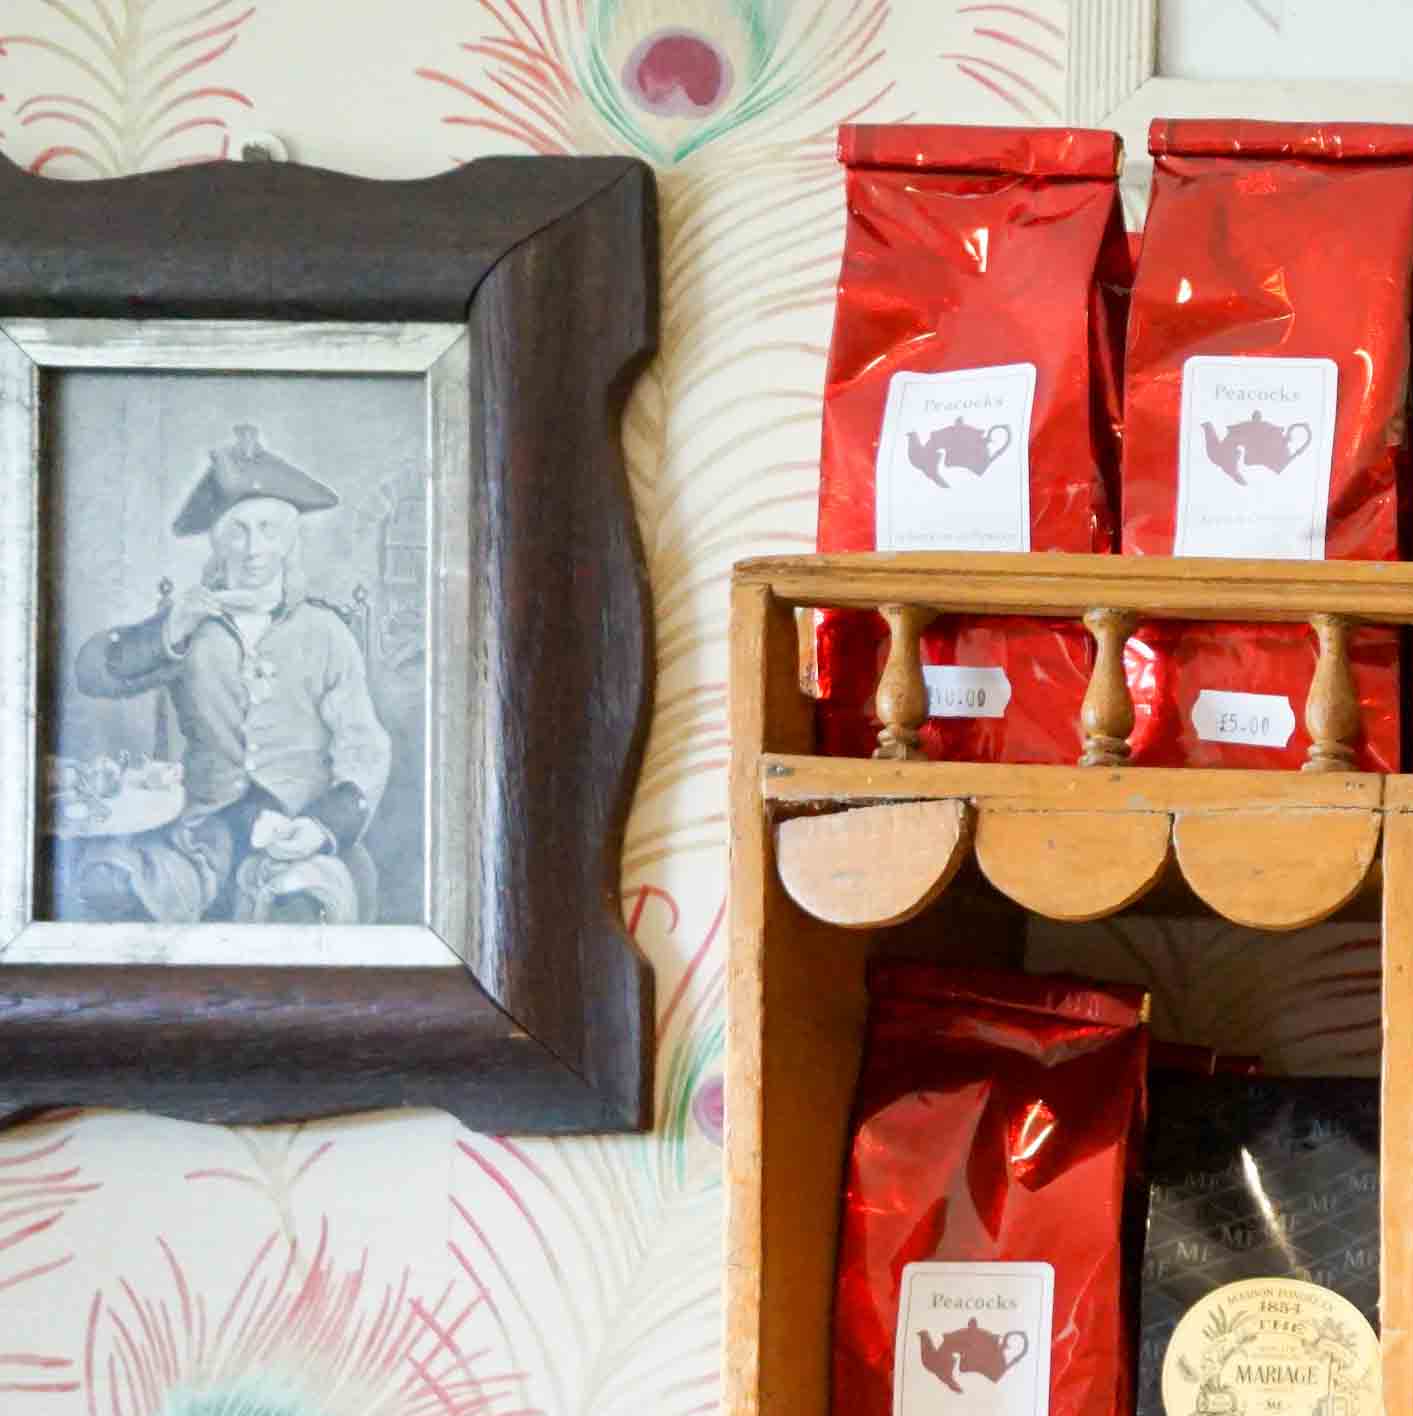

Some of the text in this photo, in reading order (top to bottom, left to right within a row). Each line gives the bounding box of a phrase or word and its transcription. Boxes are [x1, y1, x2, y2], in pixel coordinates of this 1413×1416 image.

[922, 393, 1005, 411] Peacocks
[1215, 383, 1302, 402] Peacocks
[1217, 713, 1268, 736] £5.00
[932, 1292, 1018, 1311] Peacocks
[1234, 1365, 1319, 1386] MARIAGE
